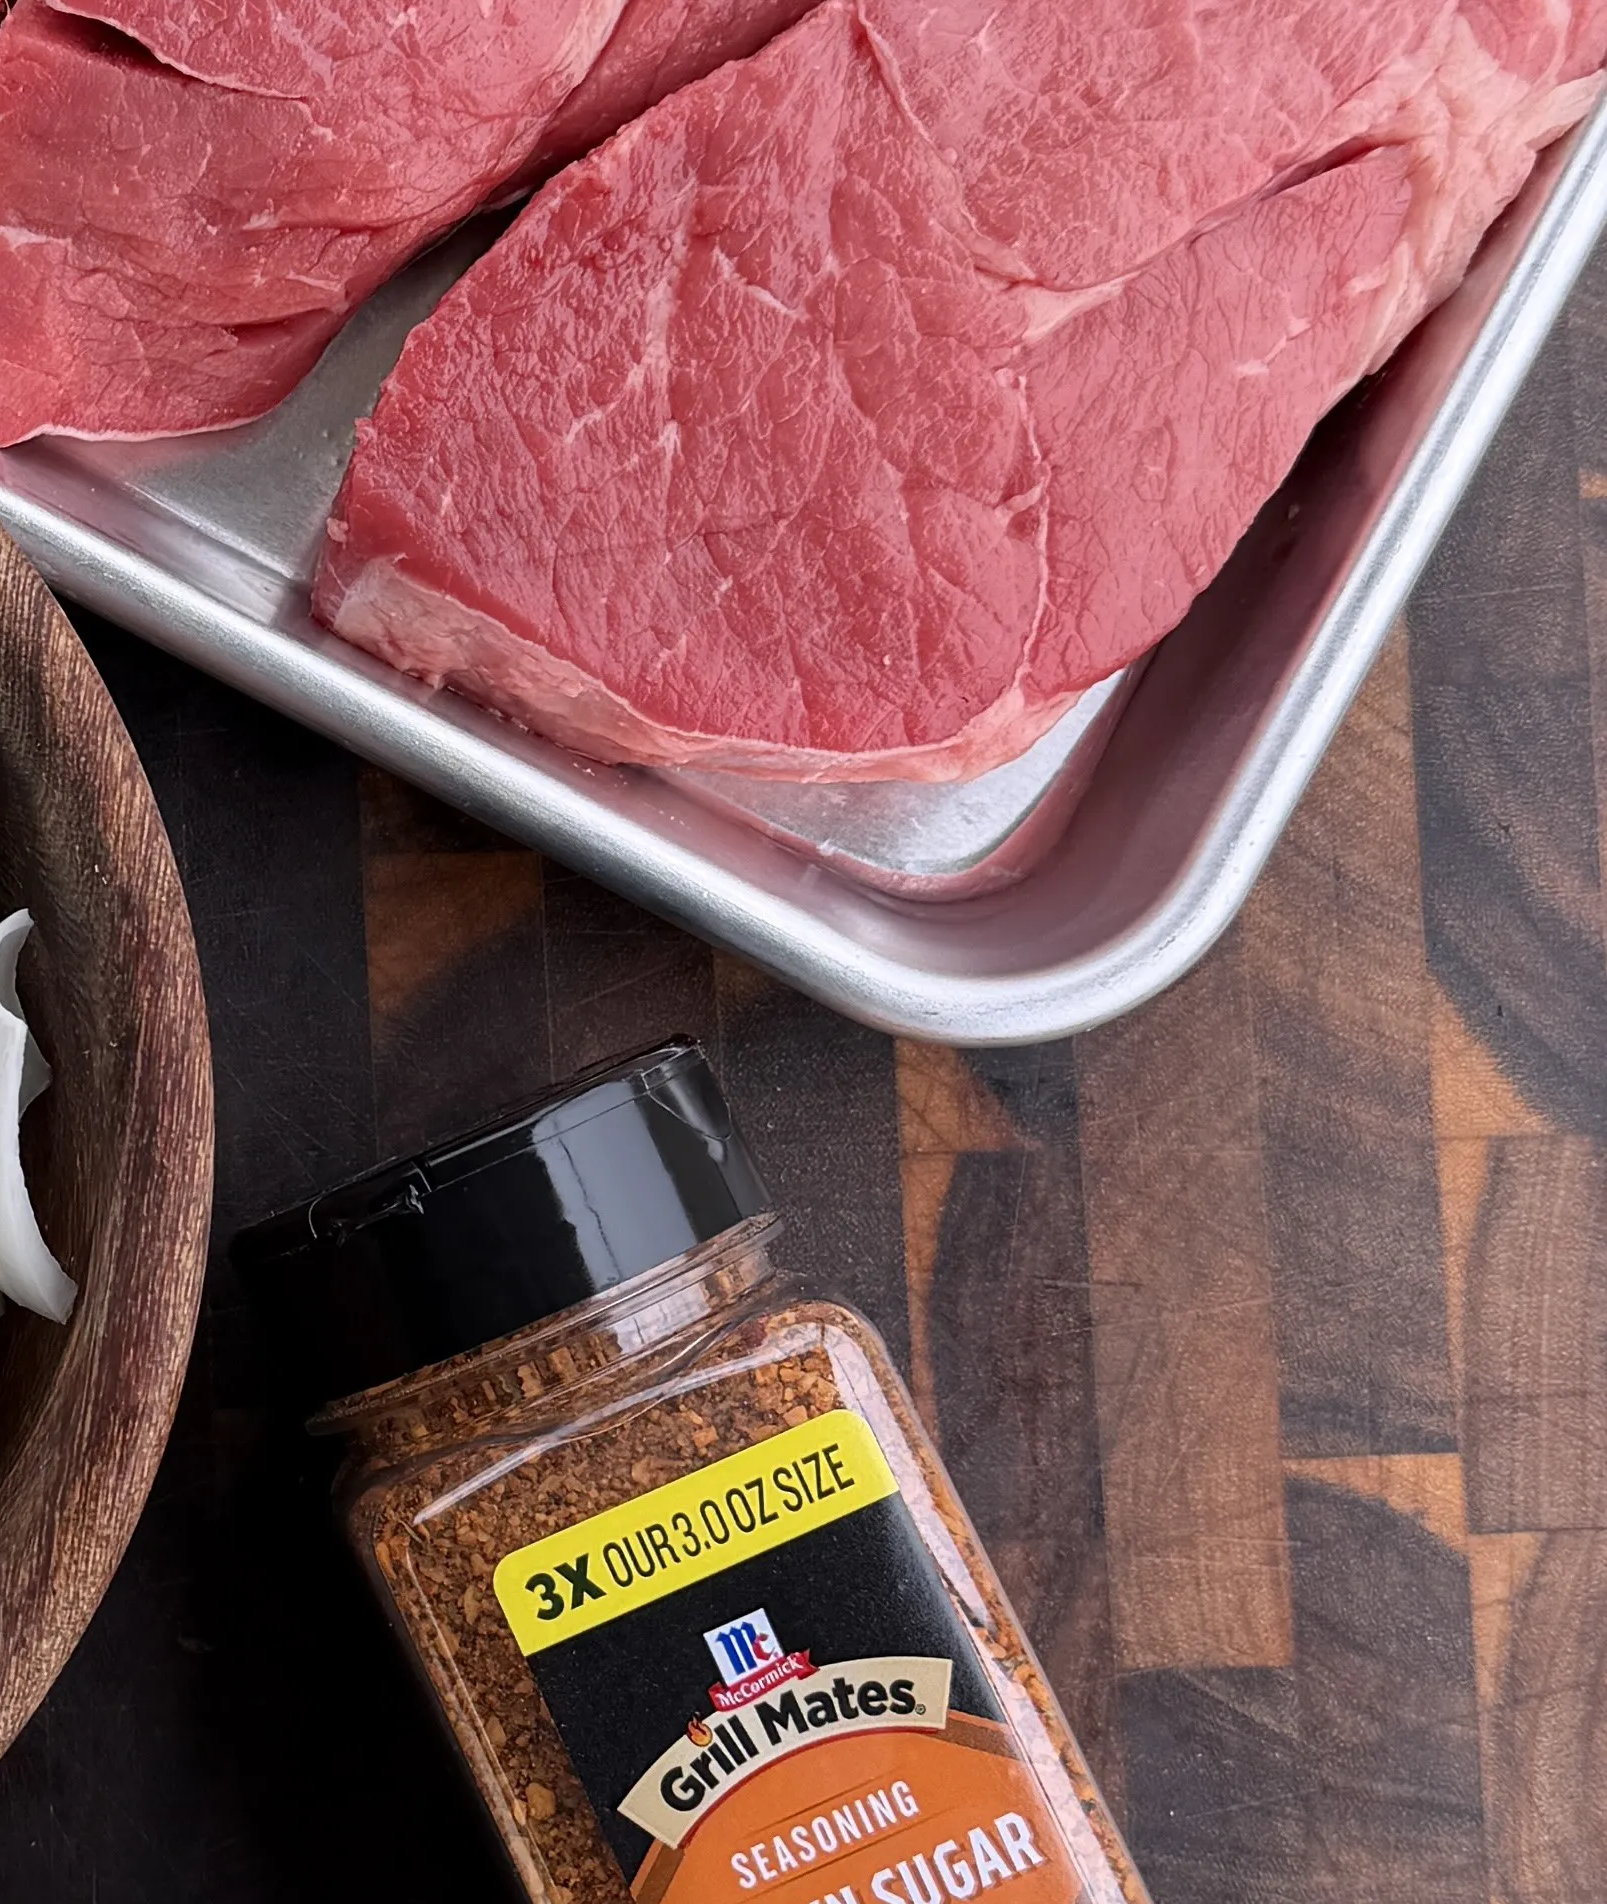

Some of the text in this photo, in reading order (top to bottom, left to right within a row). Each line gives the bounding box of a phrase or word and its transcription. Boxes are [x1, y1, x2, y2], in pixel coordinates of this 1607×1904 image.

[525, 1443, 855, 1621] 3X OUR 3.0 OZ SIZE
[715, 1652, 804, 1707] McCormick
[659, 1724, 756, 1813] Grill
[730, 1780, 920, 1890] SEASONING
